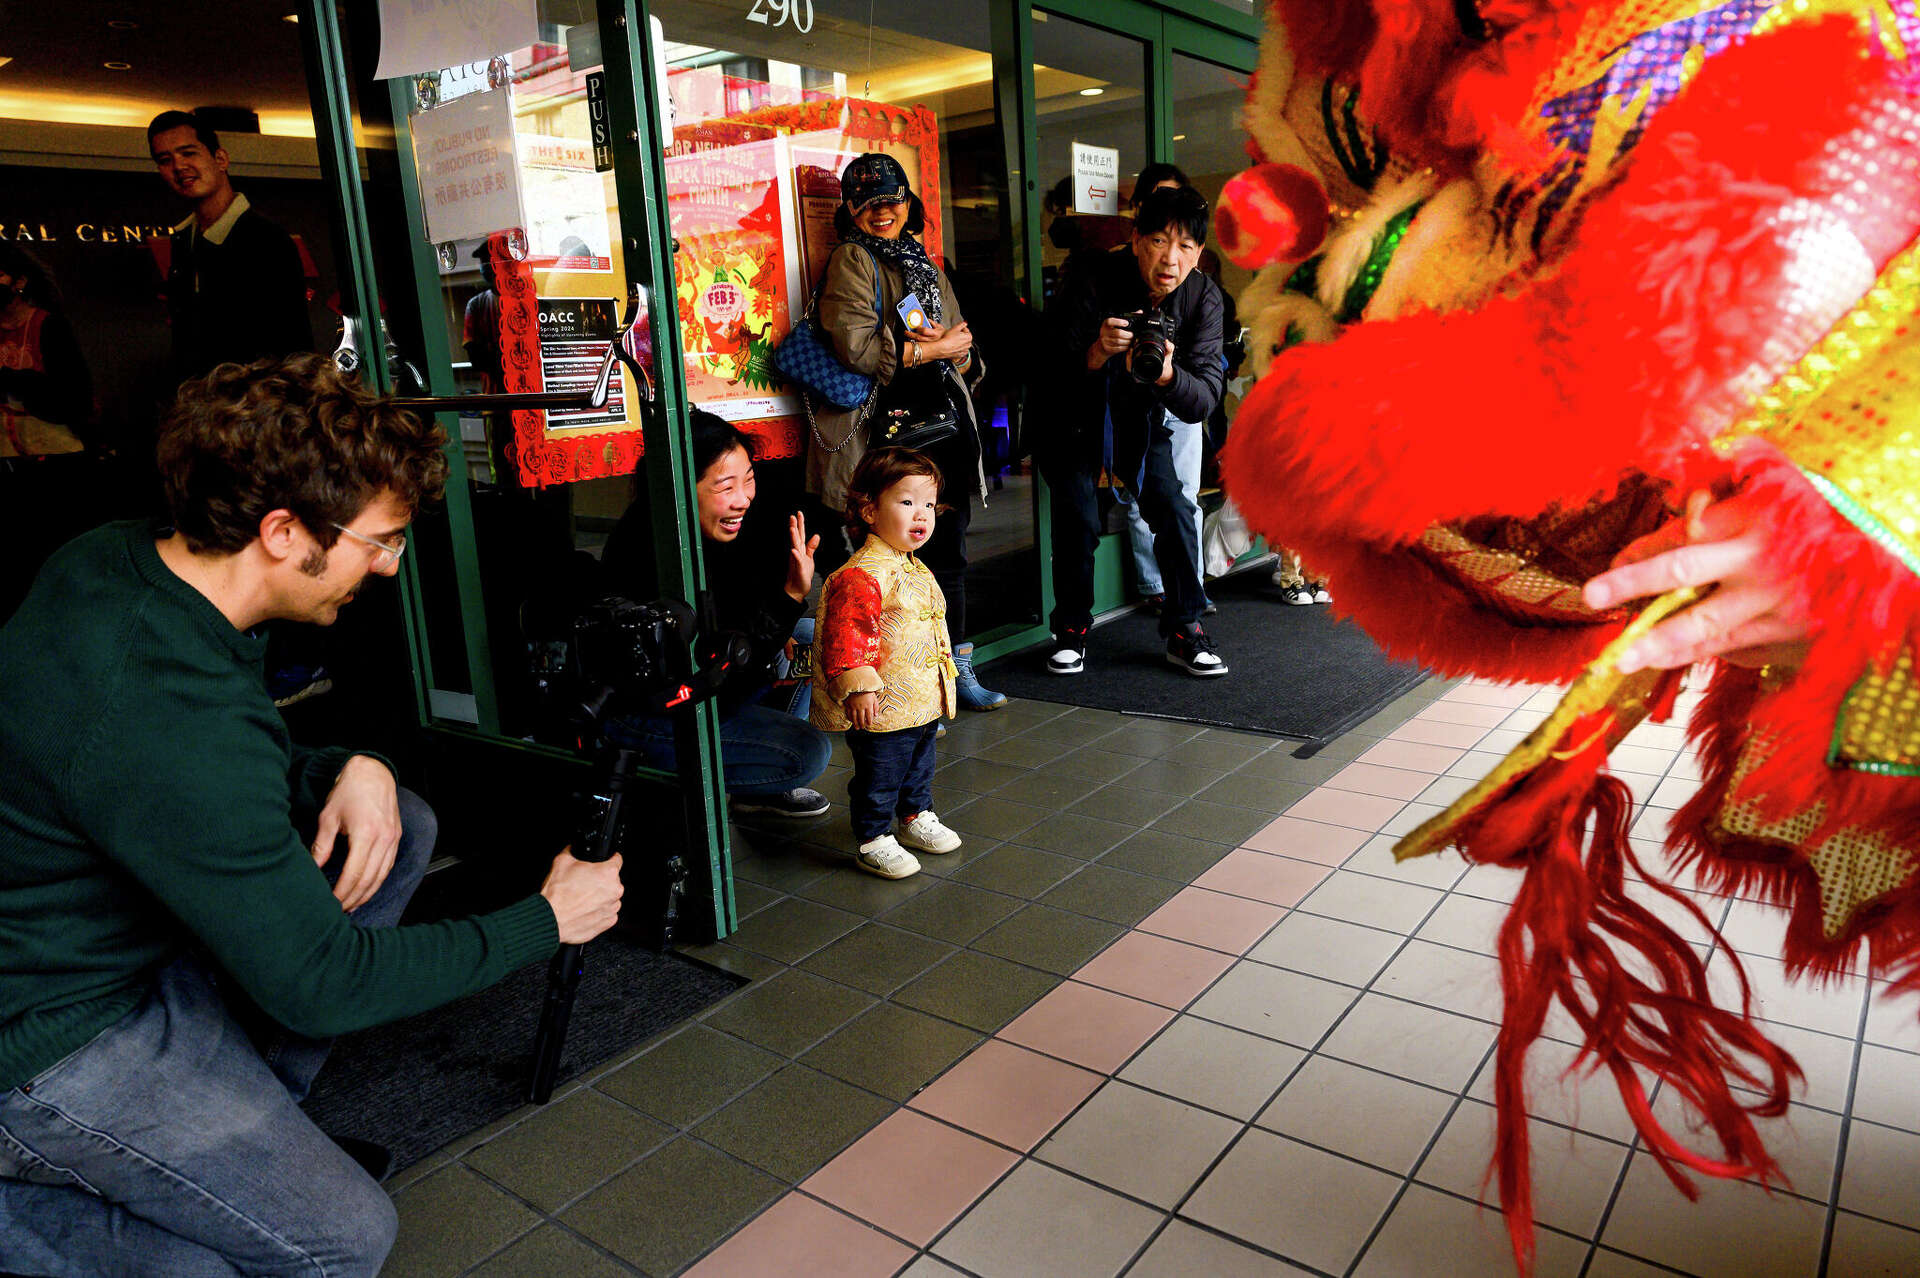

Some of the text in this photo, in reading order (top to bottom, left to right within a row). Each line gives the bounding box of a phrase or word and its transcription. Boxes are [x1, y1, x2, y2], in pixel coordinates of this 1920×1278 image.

[746, 0, 814, 33] 290
[589, 77, 610, 167] PUSH
[566, 150, 585, 160] SIX
[708, 291, 727, 306] FEB
[538, 312, 575, 323] OACC
